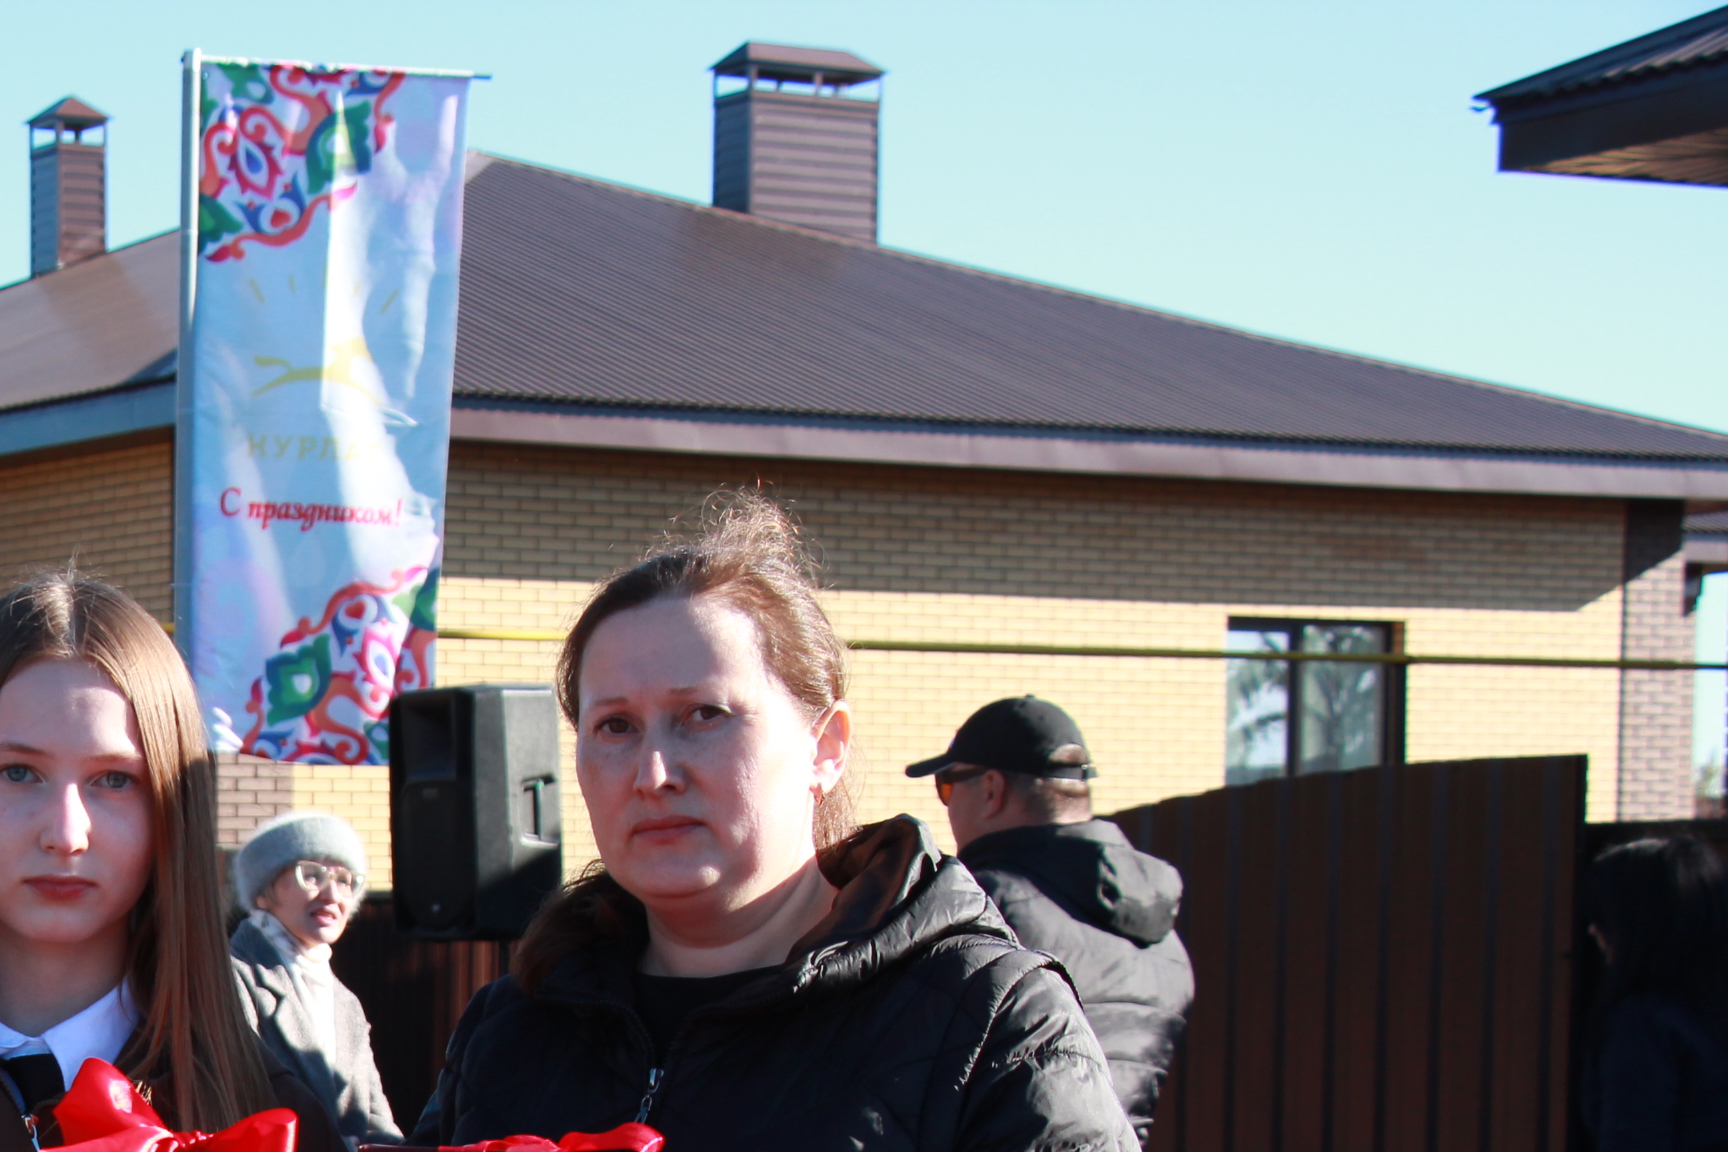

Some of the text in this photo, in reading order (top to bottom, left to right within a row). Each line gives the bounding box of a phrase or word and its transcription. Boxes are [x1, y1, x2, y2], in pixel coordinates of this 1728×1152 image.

[246, 434, 380, 461] НУРЛА
[220, 487, 404, 532] С праздником!
